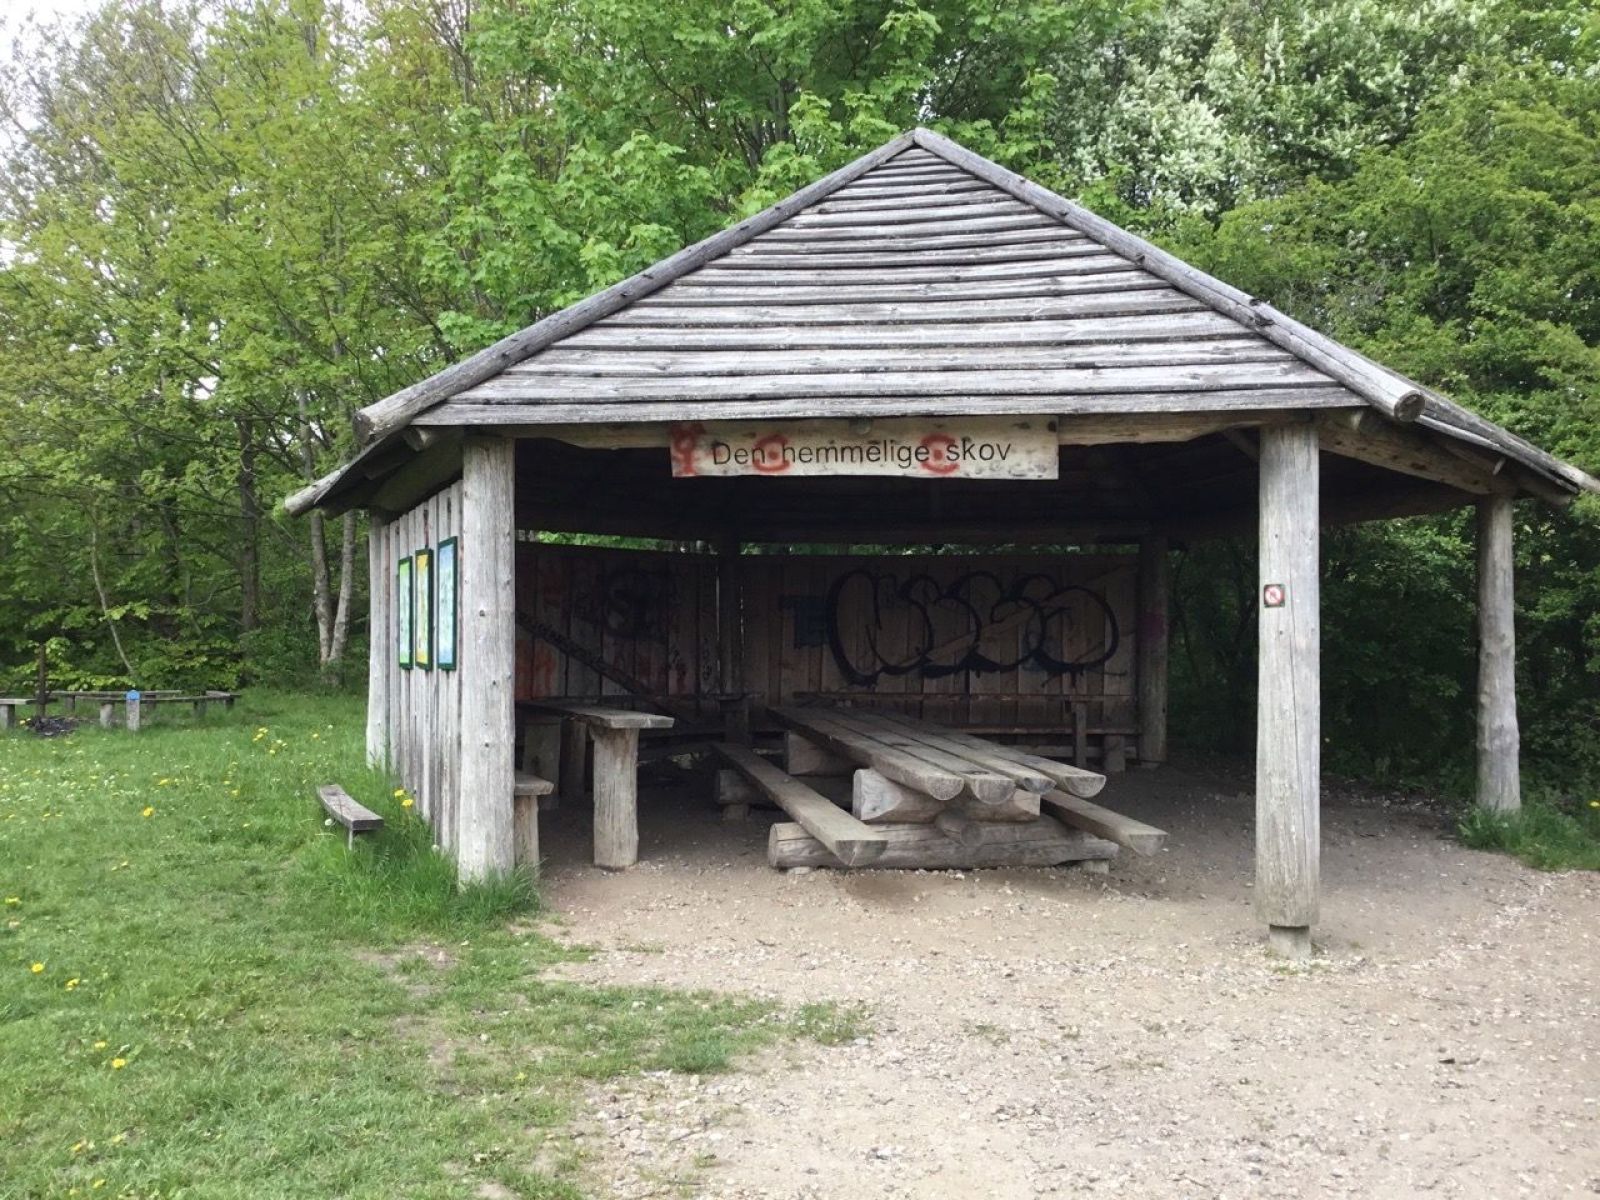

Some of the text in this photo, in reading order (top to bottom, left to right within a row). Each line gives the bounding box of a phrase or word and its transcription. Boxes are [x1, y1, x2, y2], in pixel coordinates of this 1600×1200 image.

[713, 439, 1012, 469] Den hemmelige skov
